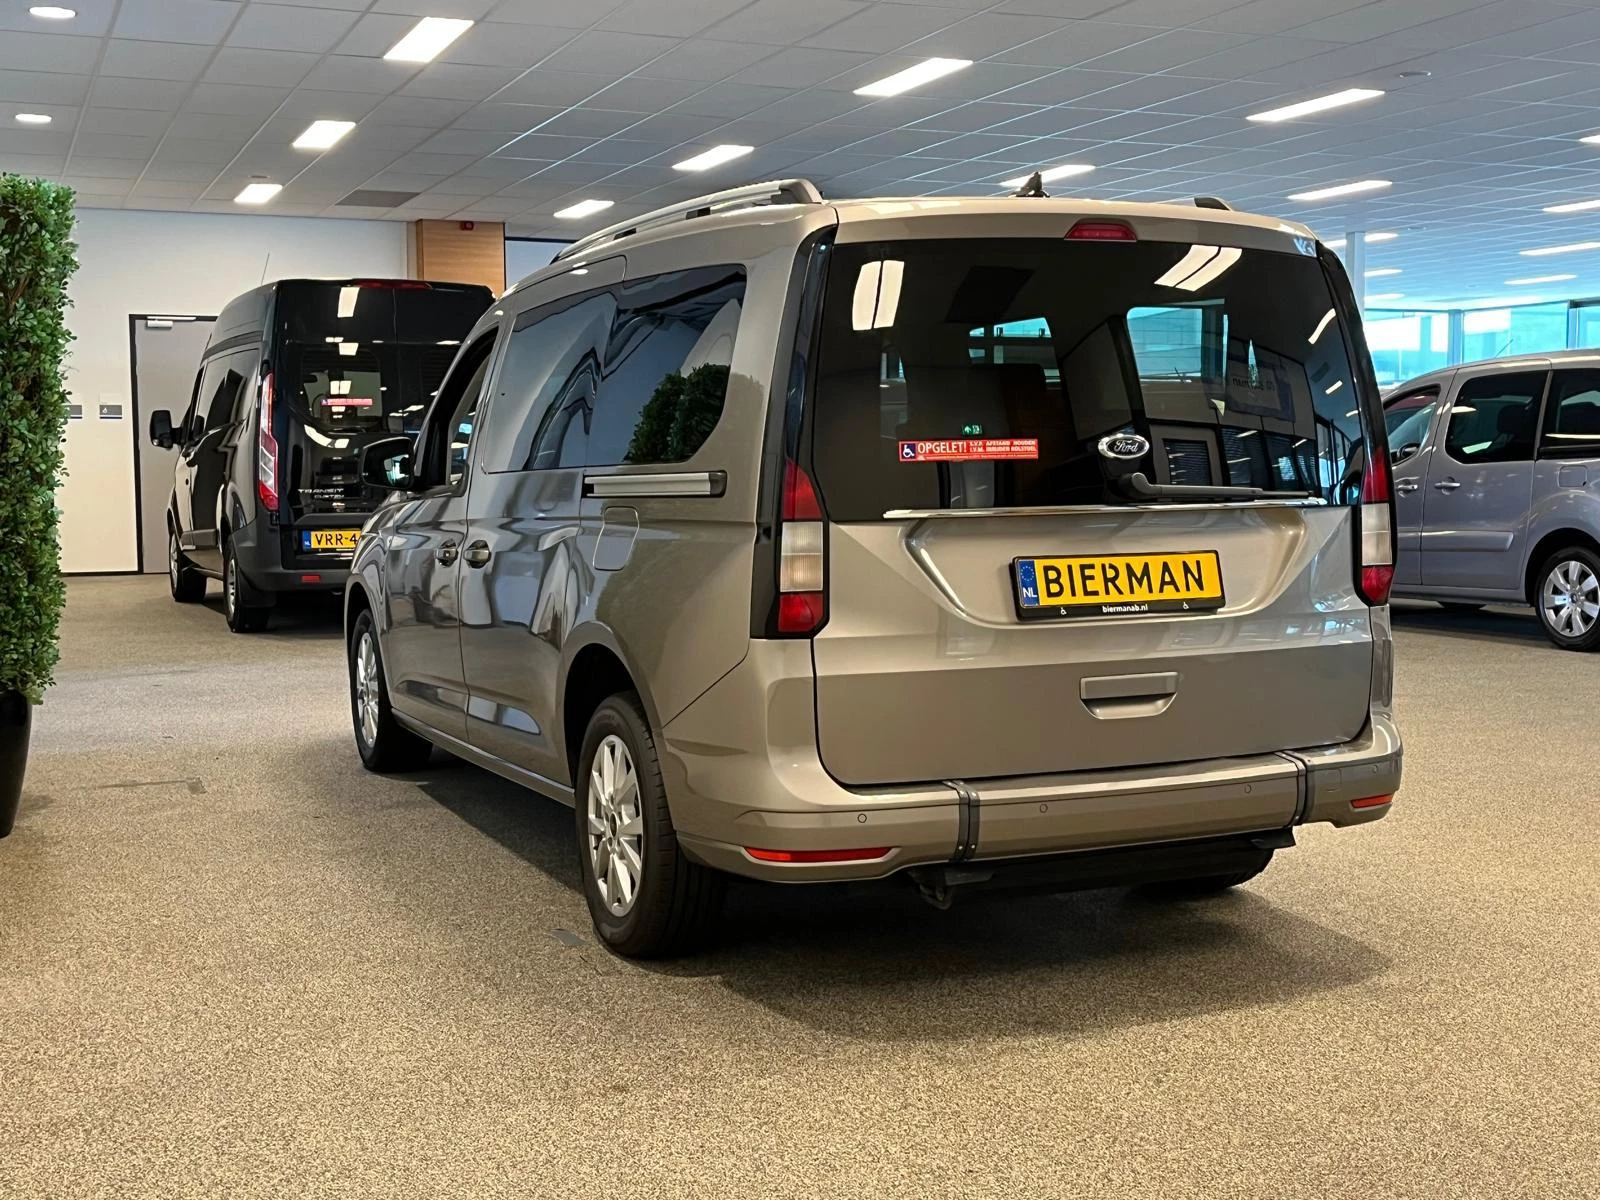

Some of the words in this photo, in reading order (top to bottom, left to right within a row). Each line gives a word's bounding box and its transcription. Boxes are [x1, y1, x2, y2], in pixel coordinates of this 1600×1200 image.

[917, 441, 967, 454] OPGELET!
[1113, 439, 1139, 453] Ford
[1042, 559, 1205, 599] BIERMAN
[1022, 587, 1038, 599] NL
[1102, 603, 1149, 613] biermanab.nl
